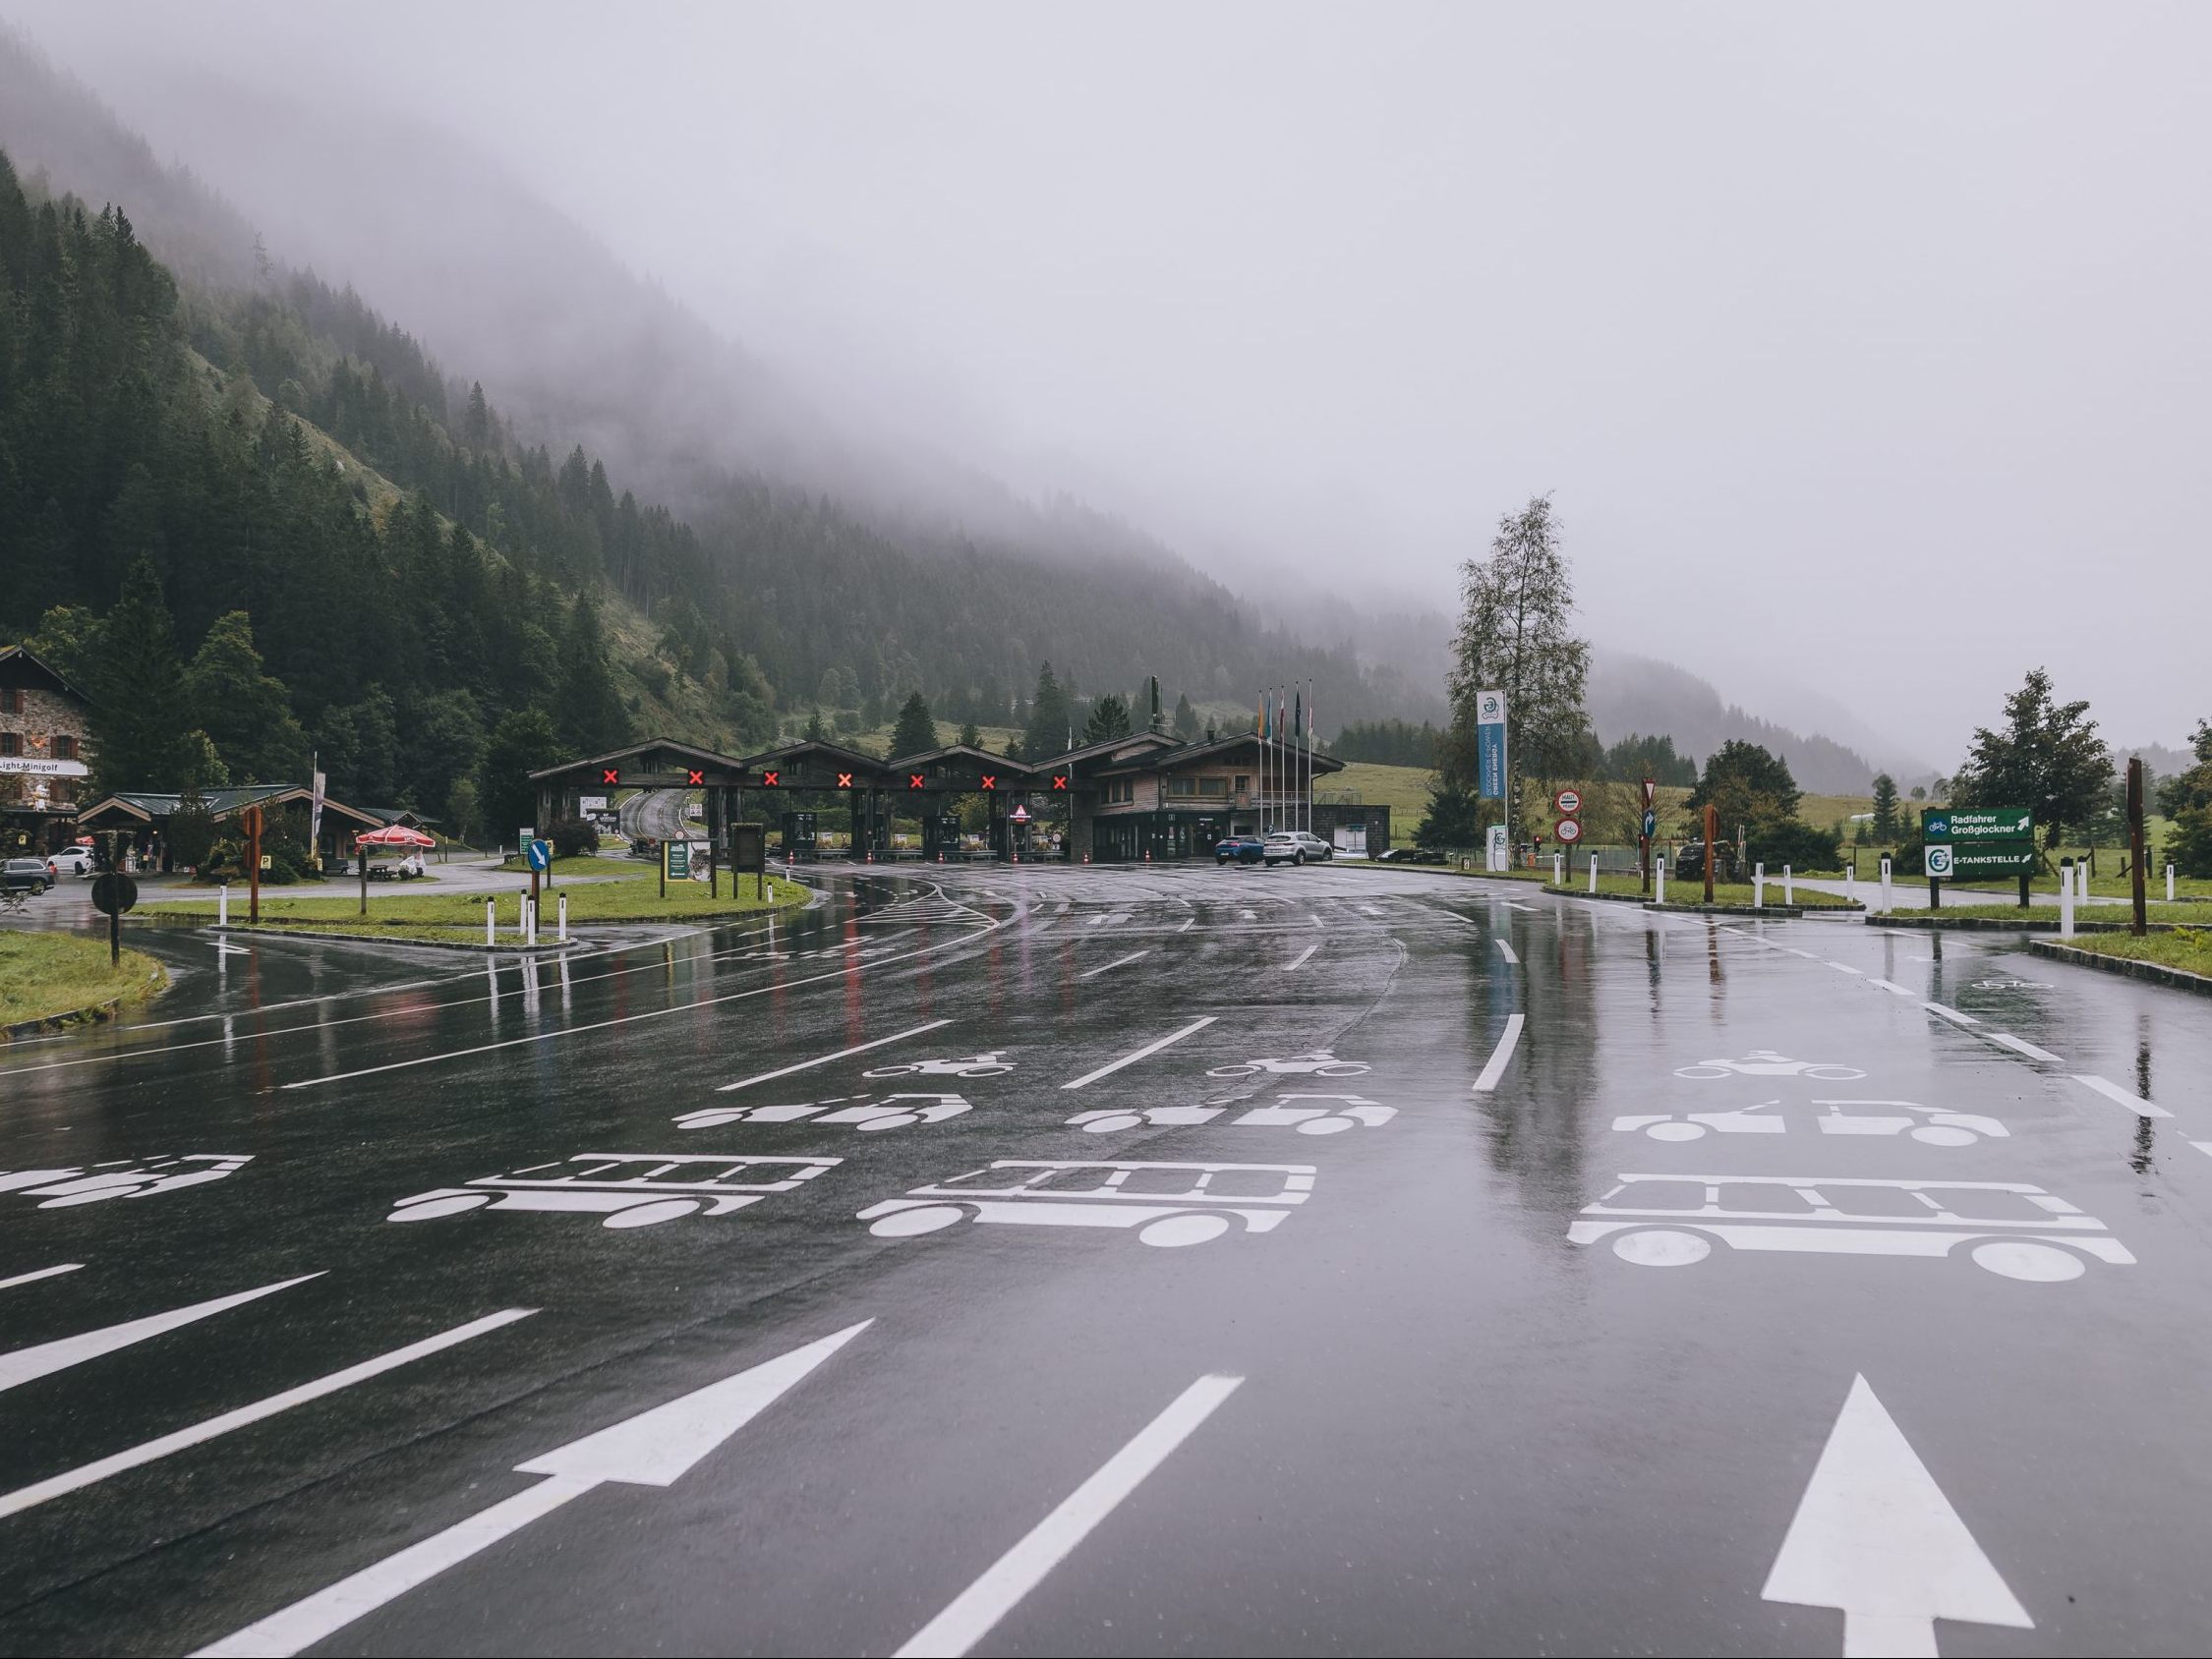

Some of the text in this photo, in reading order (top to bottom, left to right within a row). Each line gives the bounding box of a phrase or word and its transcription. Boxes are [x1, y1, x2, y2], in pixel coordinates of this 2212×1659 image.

[1950, 815, 1997, 824] Radfahrer
[1268, 825, 1273, 834] P
[1950, 825, 2015, 834] Großglockner
[1953, 855, 2020, 865] E-TANKSTELLE
